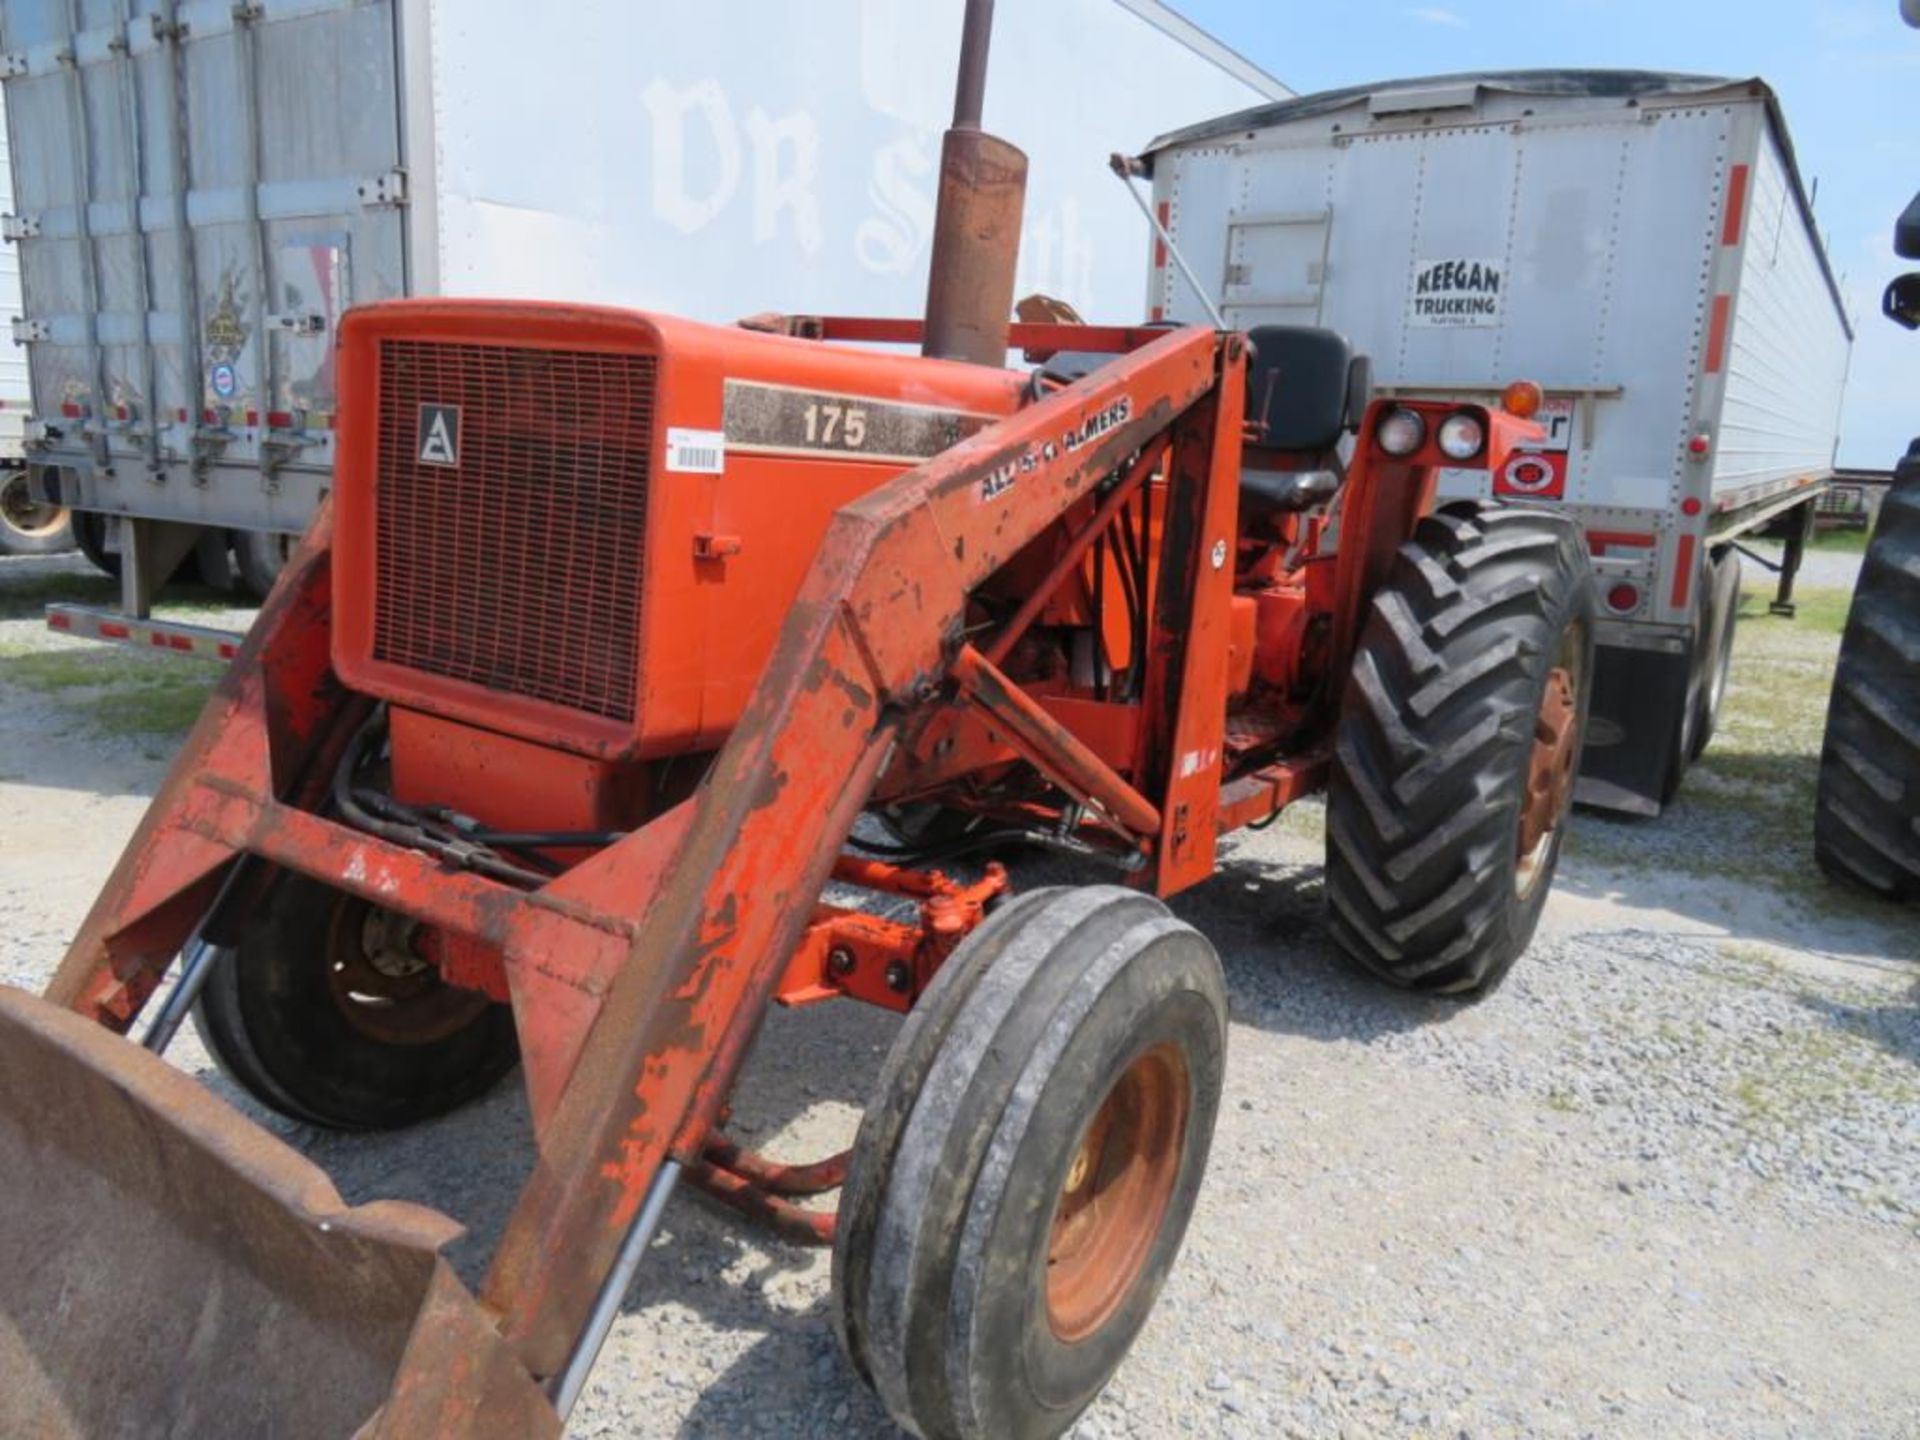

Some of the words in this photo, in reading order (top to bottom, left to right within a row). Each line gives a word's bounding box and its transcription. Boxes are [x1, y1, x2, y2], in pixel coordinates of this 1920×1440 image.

[1416, 260, 1499, 294] KEEGAN
[1415, 298, 1496, 315] TRUCKING
[803, 404, 867, 446] 175
